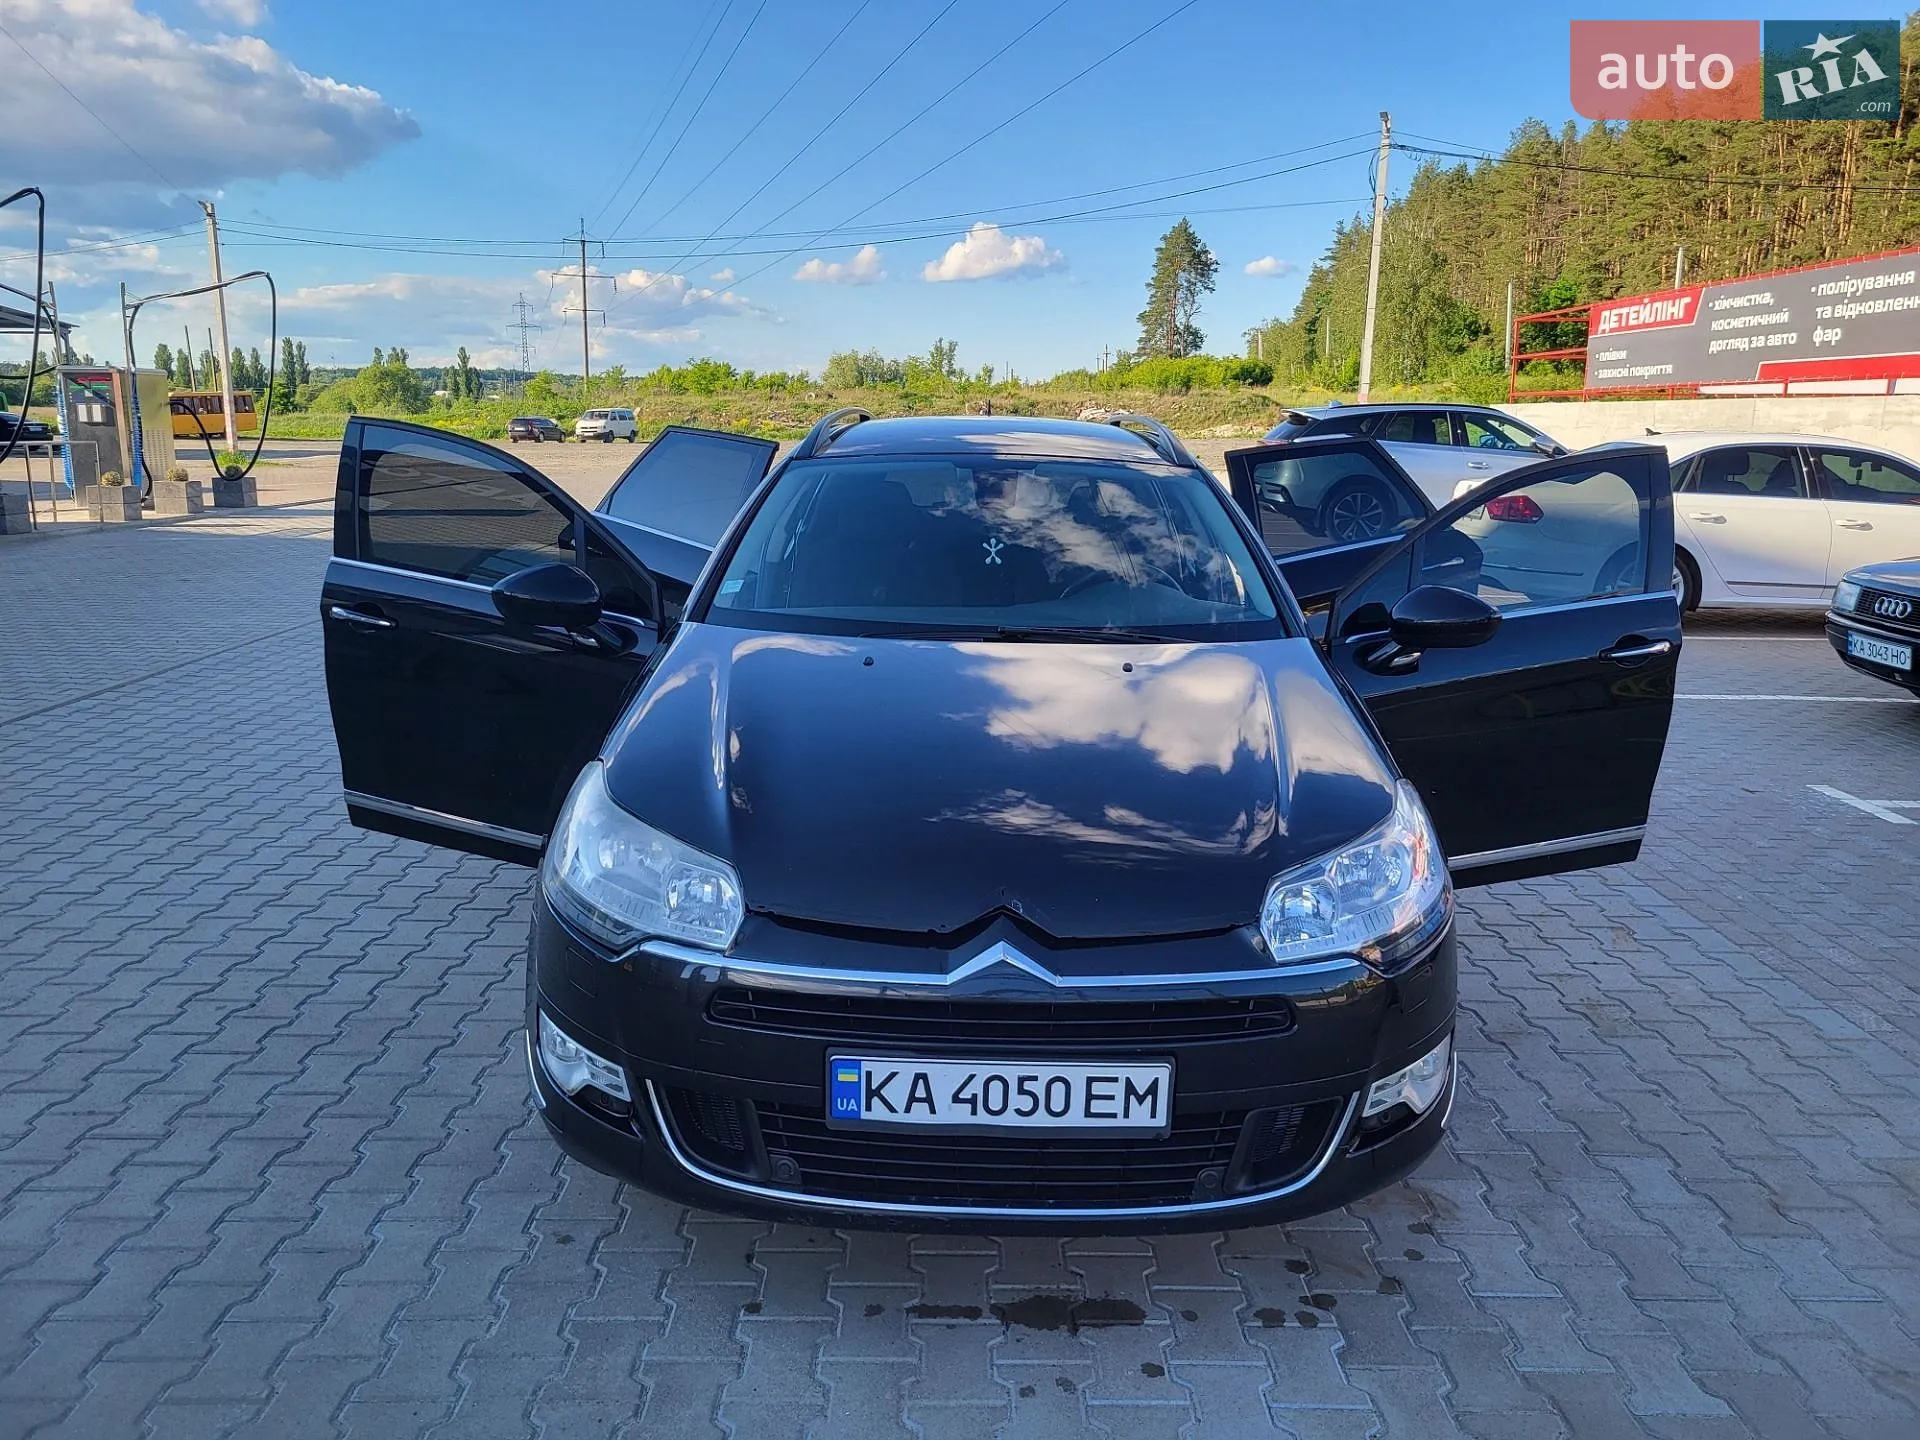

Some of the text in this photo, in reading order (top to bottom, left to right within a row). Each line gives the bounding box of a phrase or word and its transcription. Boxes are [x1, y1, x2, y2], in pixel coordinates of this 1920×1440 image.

[1817, 270, 1915, 299] полірування
[1713, 291, 1775, 311] хімчистка,
[1815, 304, 1831, 320] та
[1597, 296, 1692, 334] ДЕТЕЙЛІНГ
[1711, 307, 1790, 331] косметичний
[1708, 332, 1798, 355] догляд за авто
[1813, 325, 1842, 347] фар
[1599, 347, 1628, 362] плівки
[1598, 364, 1673, 380] захисні покриття
[1853, 638, 1866, 655] KA
[1866, 642, 1889, 662] 3043
[1890, 649, 1906, 666] HO
[837, 1097, 859, 1112] UA
[864, 1069, 1160, 1120] KA 4050 EM
